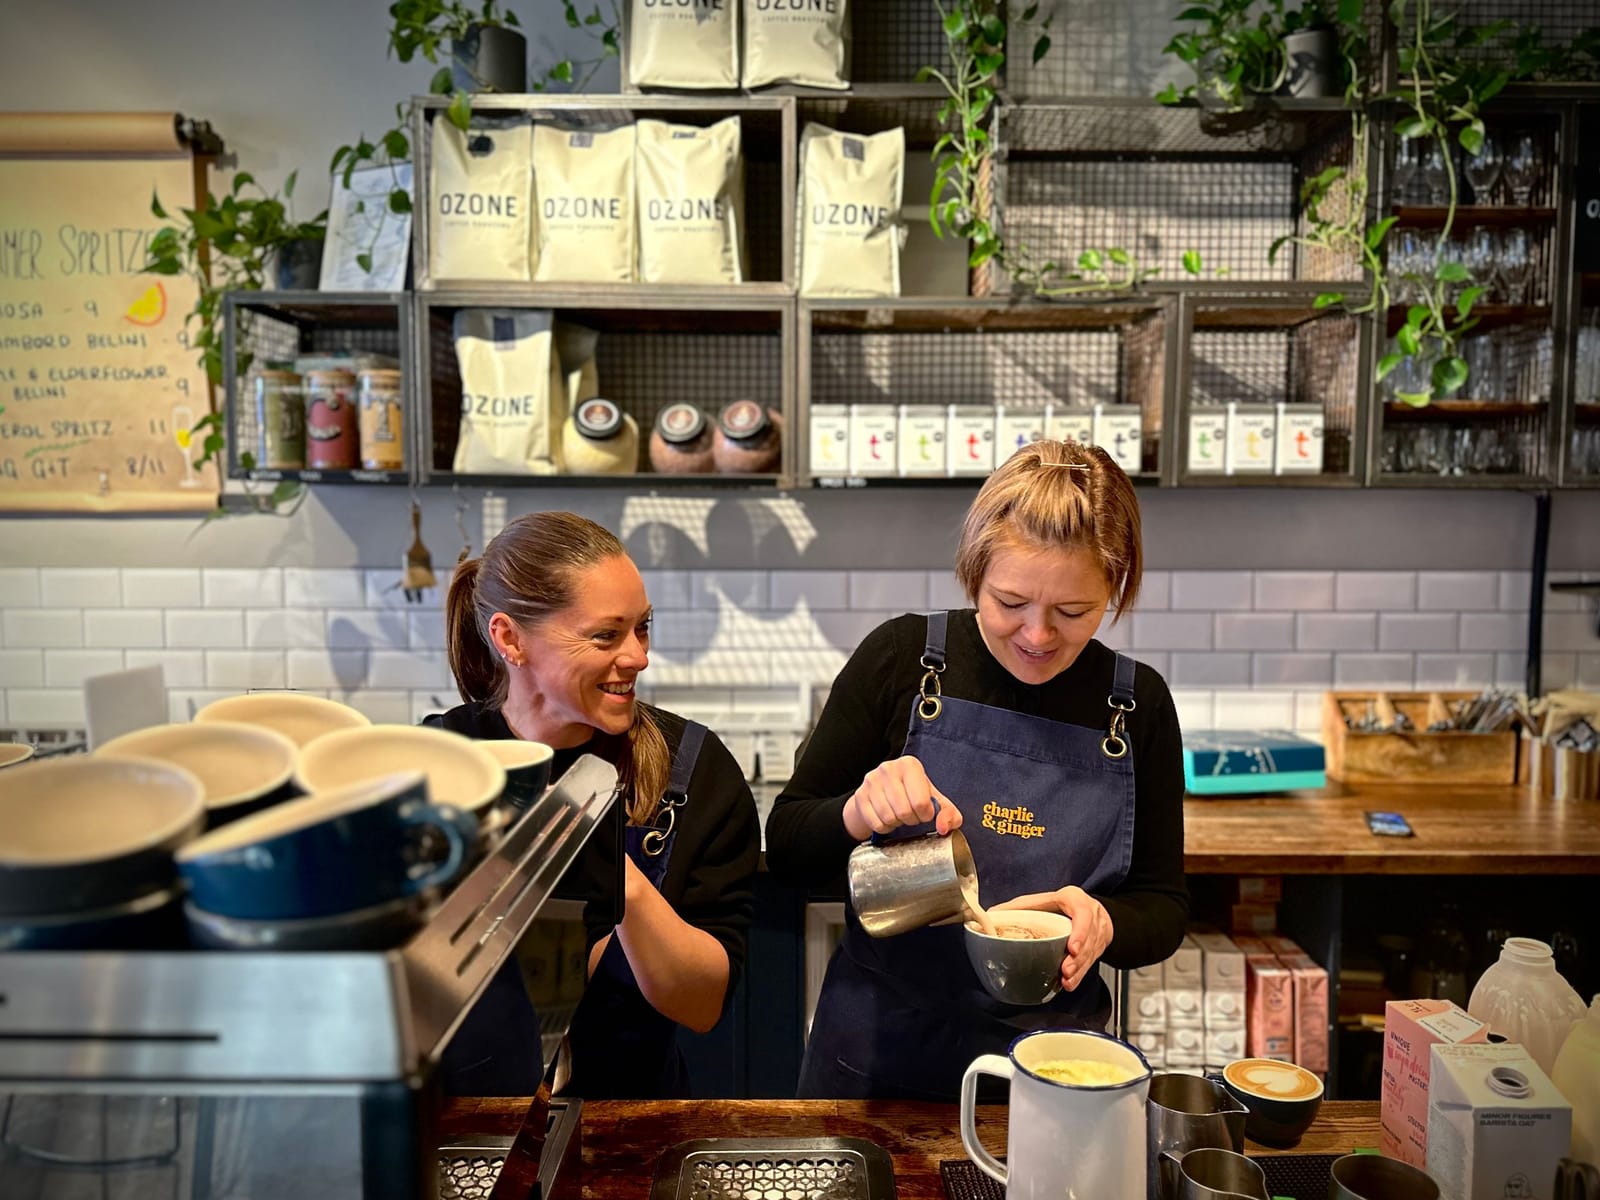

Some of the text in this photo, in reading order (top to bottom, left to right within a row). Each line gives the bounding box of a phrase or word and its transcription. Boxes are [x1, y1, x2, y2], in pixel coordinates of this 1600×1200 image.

[440, 193, 517, 217] OZONE
[544, 198, 621, 219] OZONE
[648, 198, 725, 221] OZONE
[0, 302, 43, 320] OSA
[0, 335, 70, 351] MBORD
[48, 366, 168, 383] ELDERFLOWER
[461, 393, 534, 417] OZONE
[51, 419, 113, 439] SPRITZ
[983, 801, 1034, 823] charlie
[982, 813, 1046, 839] & ginger
[1481, 1112, 1552, 1120] MINOR FIGURES
